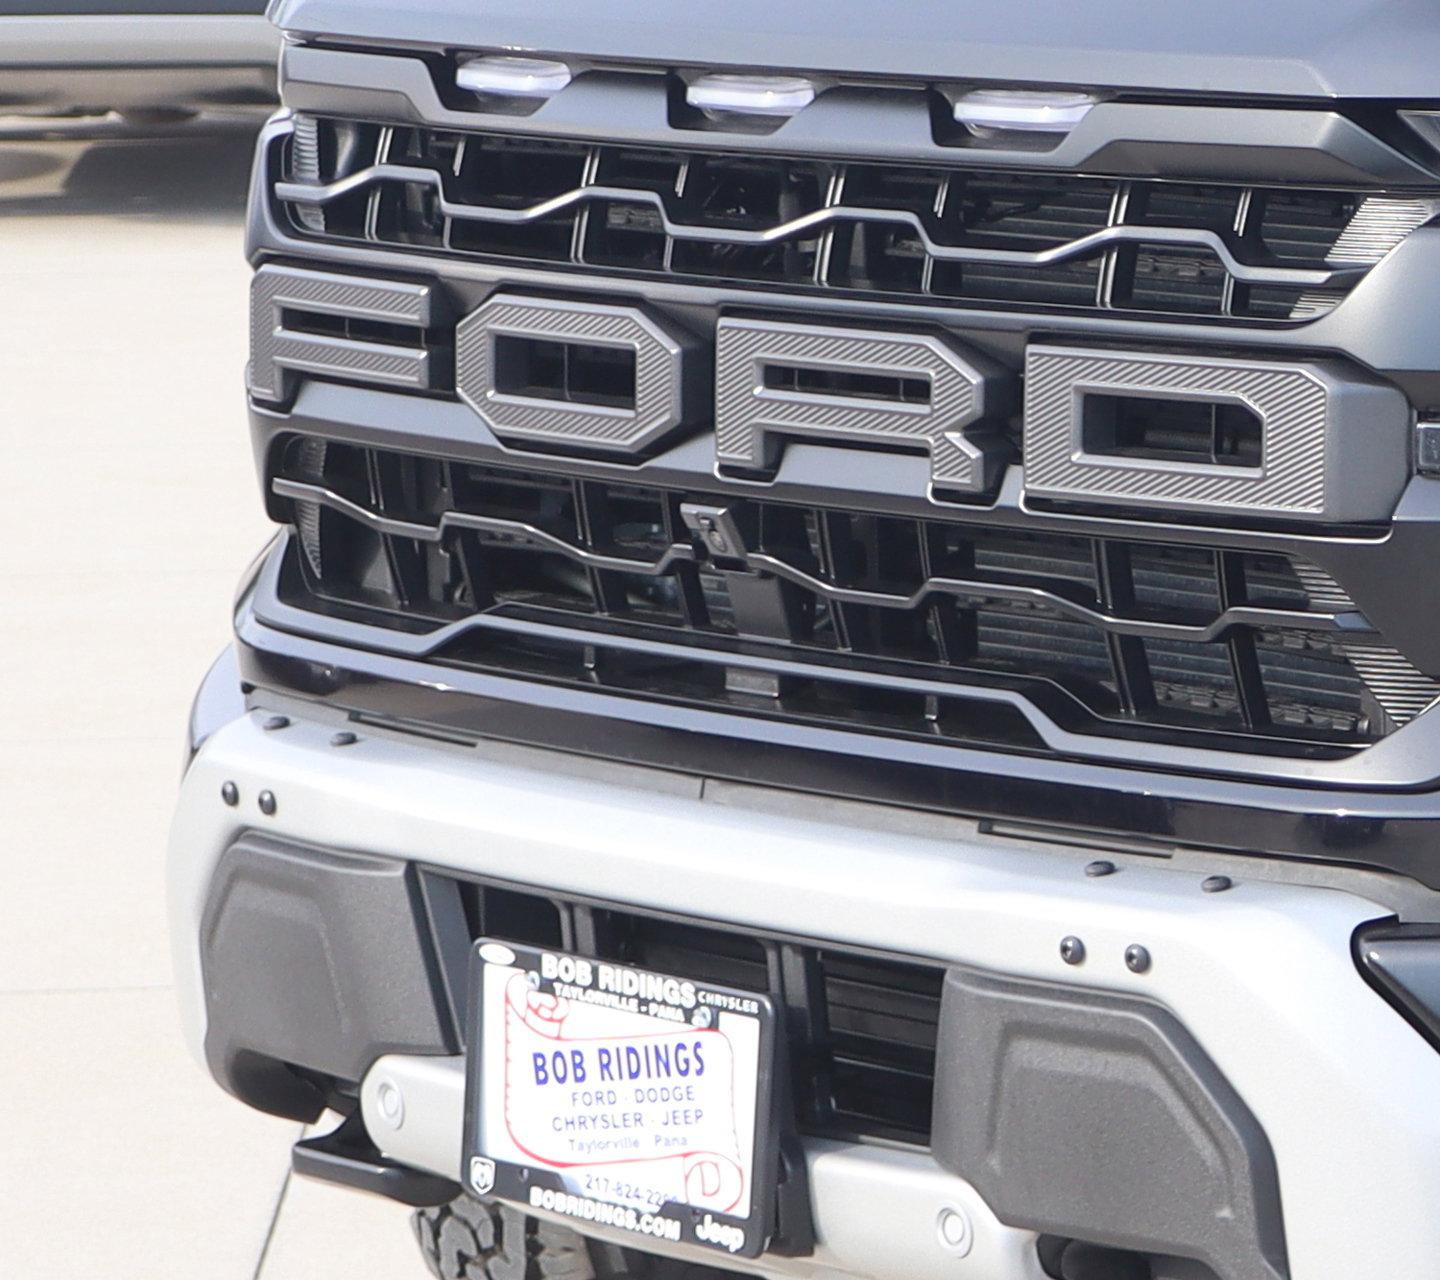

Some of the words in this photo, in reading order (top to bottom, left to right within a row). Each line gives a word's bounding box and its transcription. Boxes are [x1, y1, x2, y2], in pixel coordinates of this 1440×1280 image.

[247, 263, 1360, 525] FORD
[541, 952, 593, 988] BOB
[597, 963, 697, 1010] RIDINGS
[553, 981, 640, 1014] TAYLORVILLE
[697, 989, 760, 1015] CHRYSLER
[532, 1048, 587, 1086] BOB
[597, 1041, 705, 1082] RIDINGS
[571, 1088, 618, 1107] FORD
[634, 1085, 696, 1104] DODGE
[551, 1110, 645, 1132] CHRYSLER
[661, 1108, 704, 1127] JEEP
[568, 1135, 641, 1154] Taylorville
[654, 1134, 689, 1148] Pana
[529, 1185, 682, 1242] BOBRIDINGS.COM
[695, 1214, 745, 1253] Jeep
